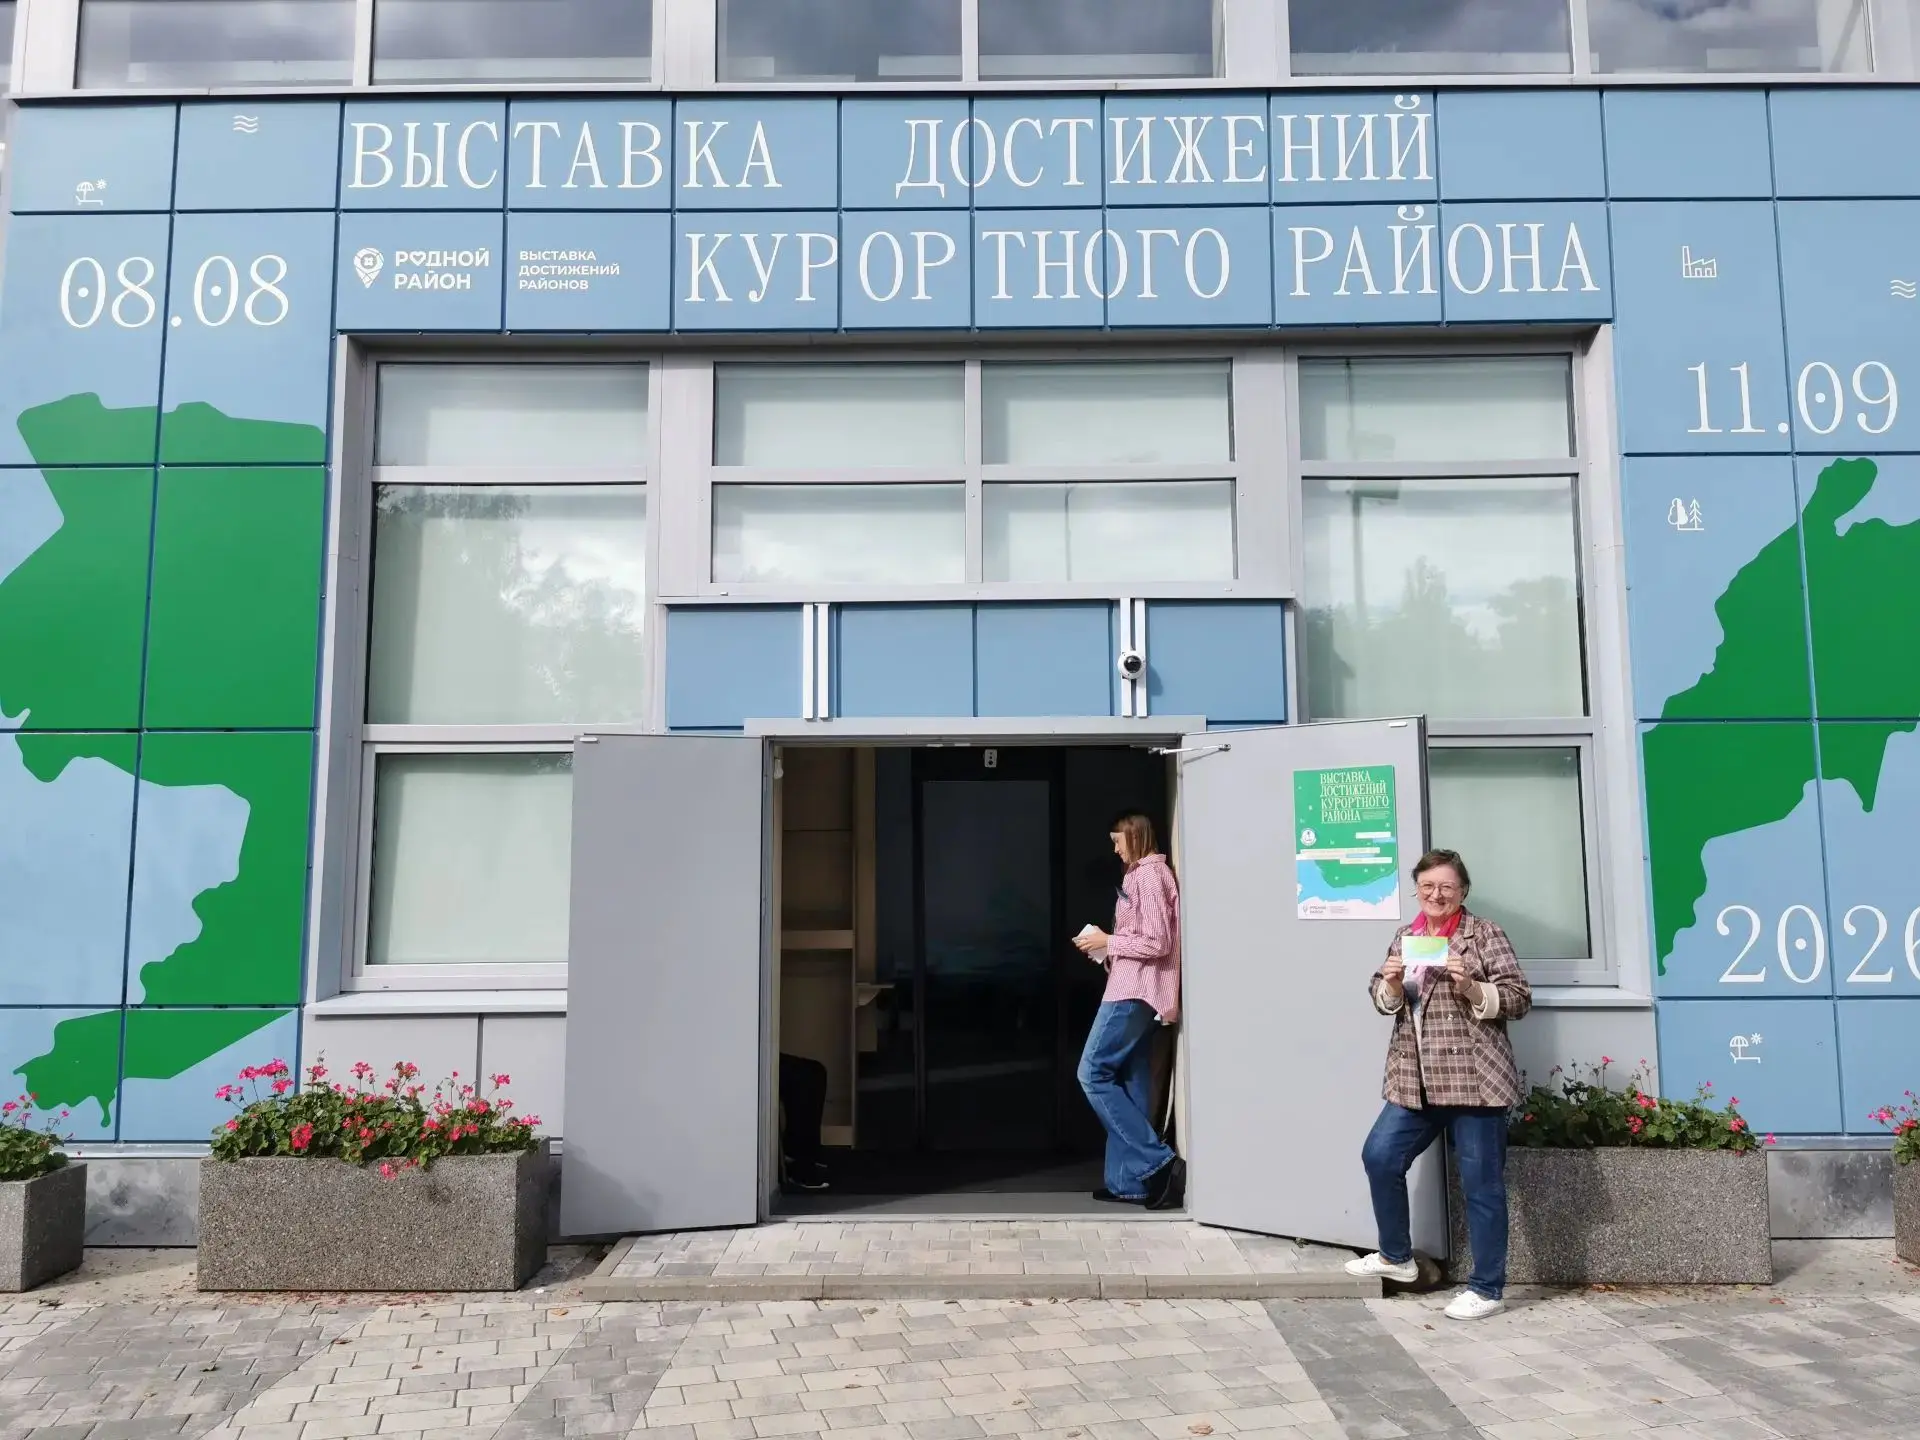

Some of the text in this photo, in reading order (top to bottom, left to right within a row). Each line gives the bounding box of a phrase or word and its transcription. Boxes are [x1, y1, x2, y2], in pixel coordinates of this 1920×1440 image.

[347, 94, 1434, 199] ВЫСТАВКА ДОСТИЖЕНИЙ
[519, 250, 597, 261] ВЫСТАВКА
[684, 205, 1600, 302] КУРОРТНОГО РАЙОНА
[519, 263, 620, 276] ДОСТИЖЕНИЙ
[394, 269, 471, 290] РАЙОН
[519, 277, 589, 290] РАЙОНОВ
[60, 254, 289, 328] 08.08
[1687, 361, 1898, 434] 11.09
[1320, 770, 1371, 785] ВЫСТАВКА
[1320, 780, 1387, 797] ДОСТИЖЕНИЙ
[1321, 796, 1389, 809] КУРОРТНОГО
[1322, 808, 1361, 822] РАЙОНА
